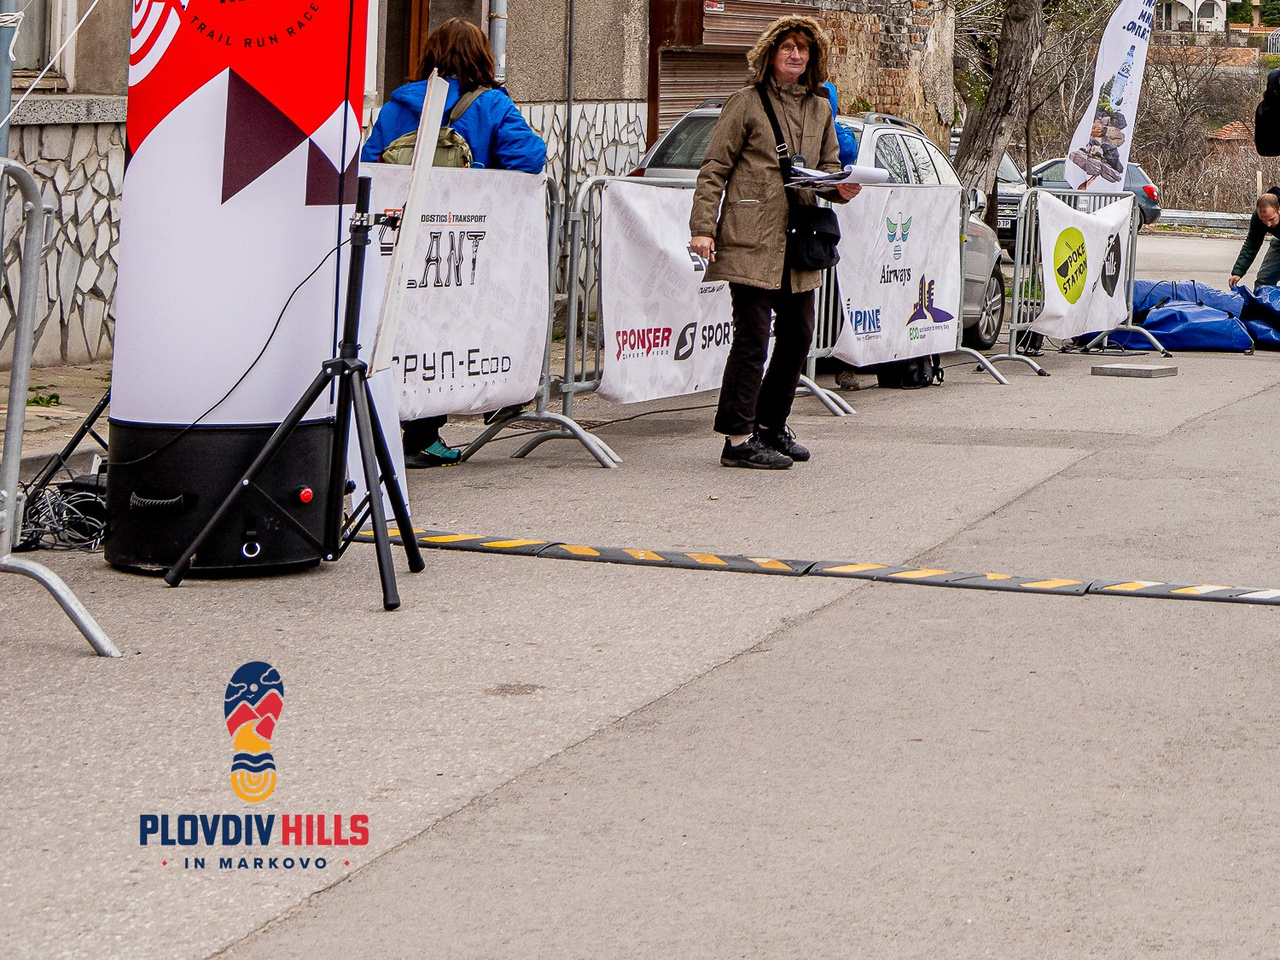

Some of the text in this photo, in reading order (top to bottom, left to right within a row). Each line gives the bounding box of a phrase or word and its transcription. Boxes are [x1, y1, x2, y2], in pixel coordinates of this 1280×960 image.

[189, 2, 320, 48] TRAIL RUN RACE
[452, 214, 487, 223] TRANSPORT
[1067, 241, 1086, 268] POKE
[879, 264, 912, 286] Airways
[850, 307, 882, 334] PINE
[615, 326, 673, 361] SPONSER
